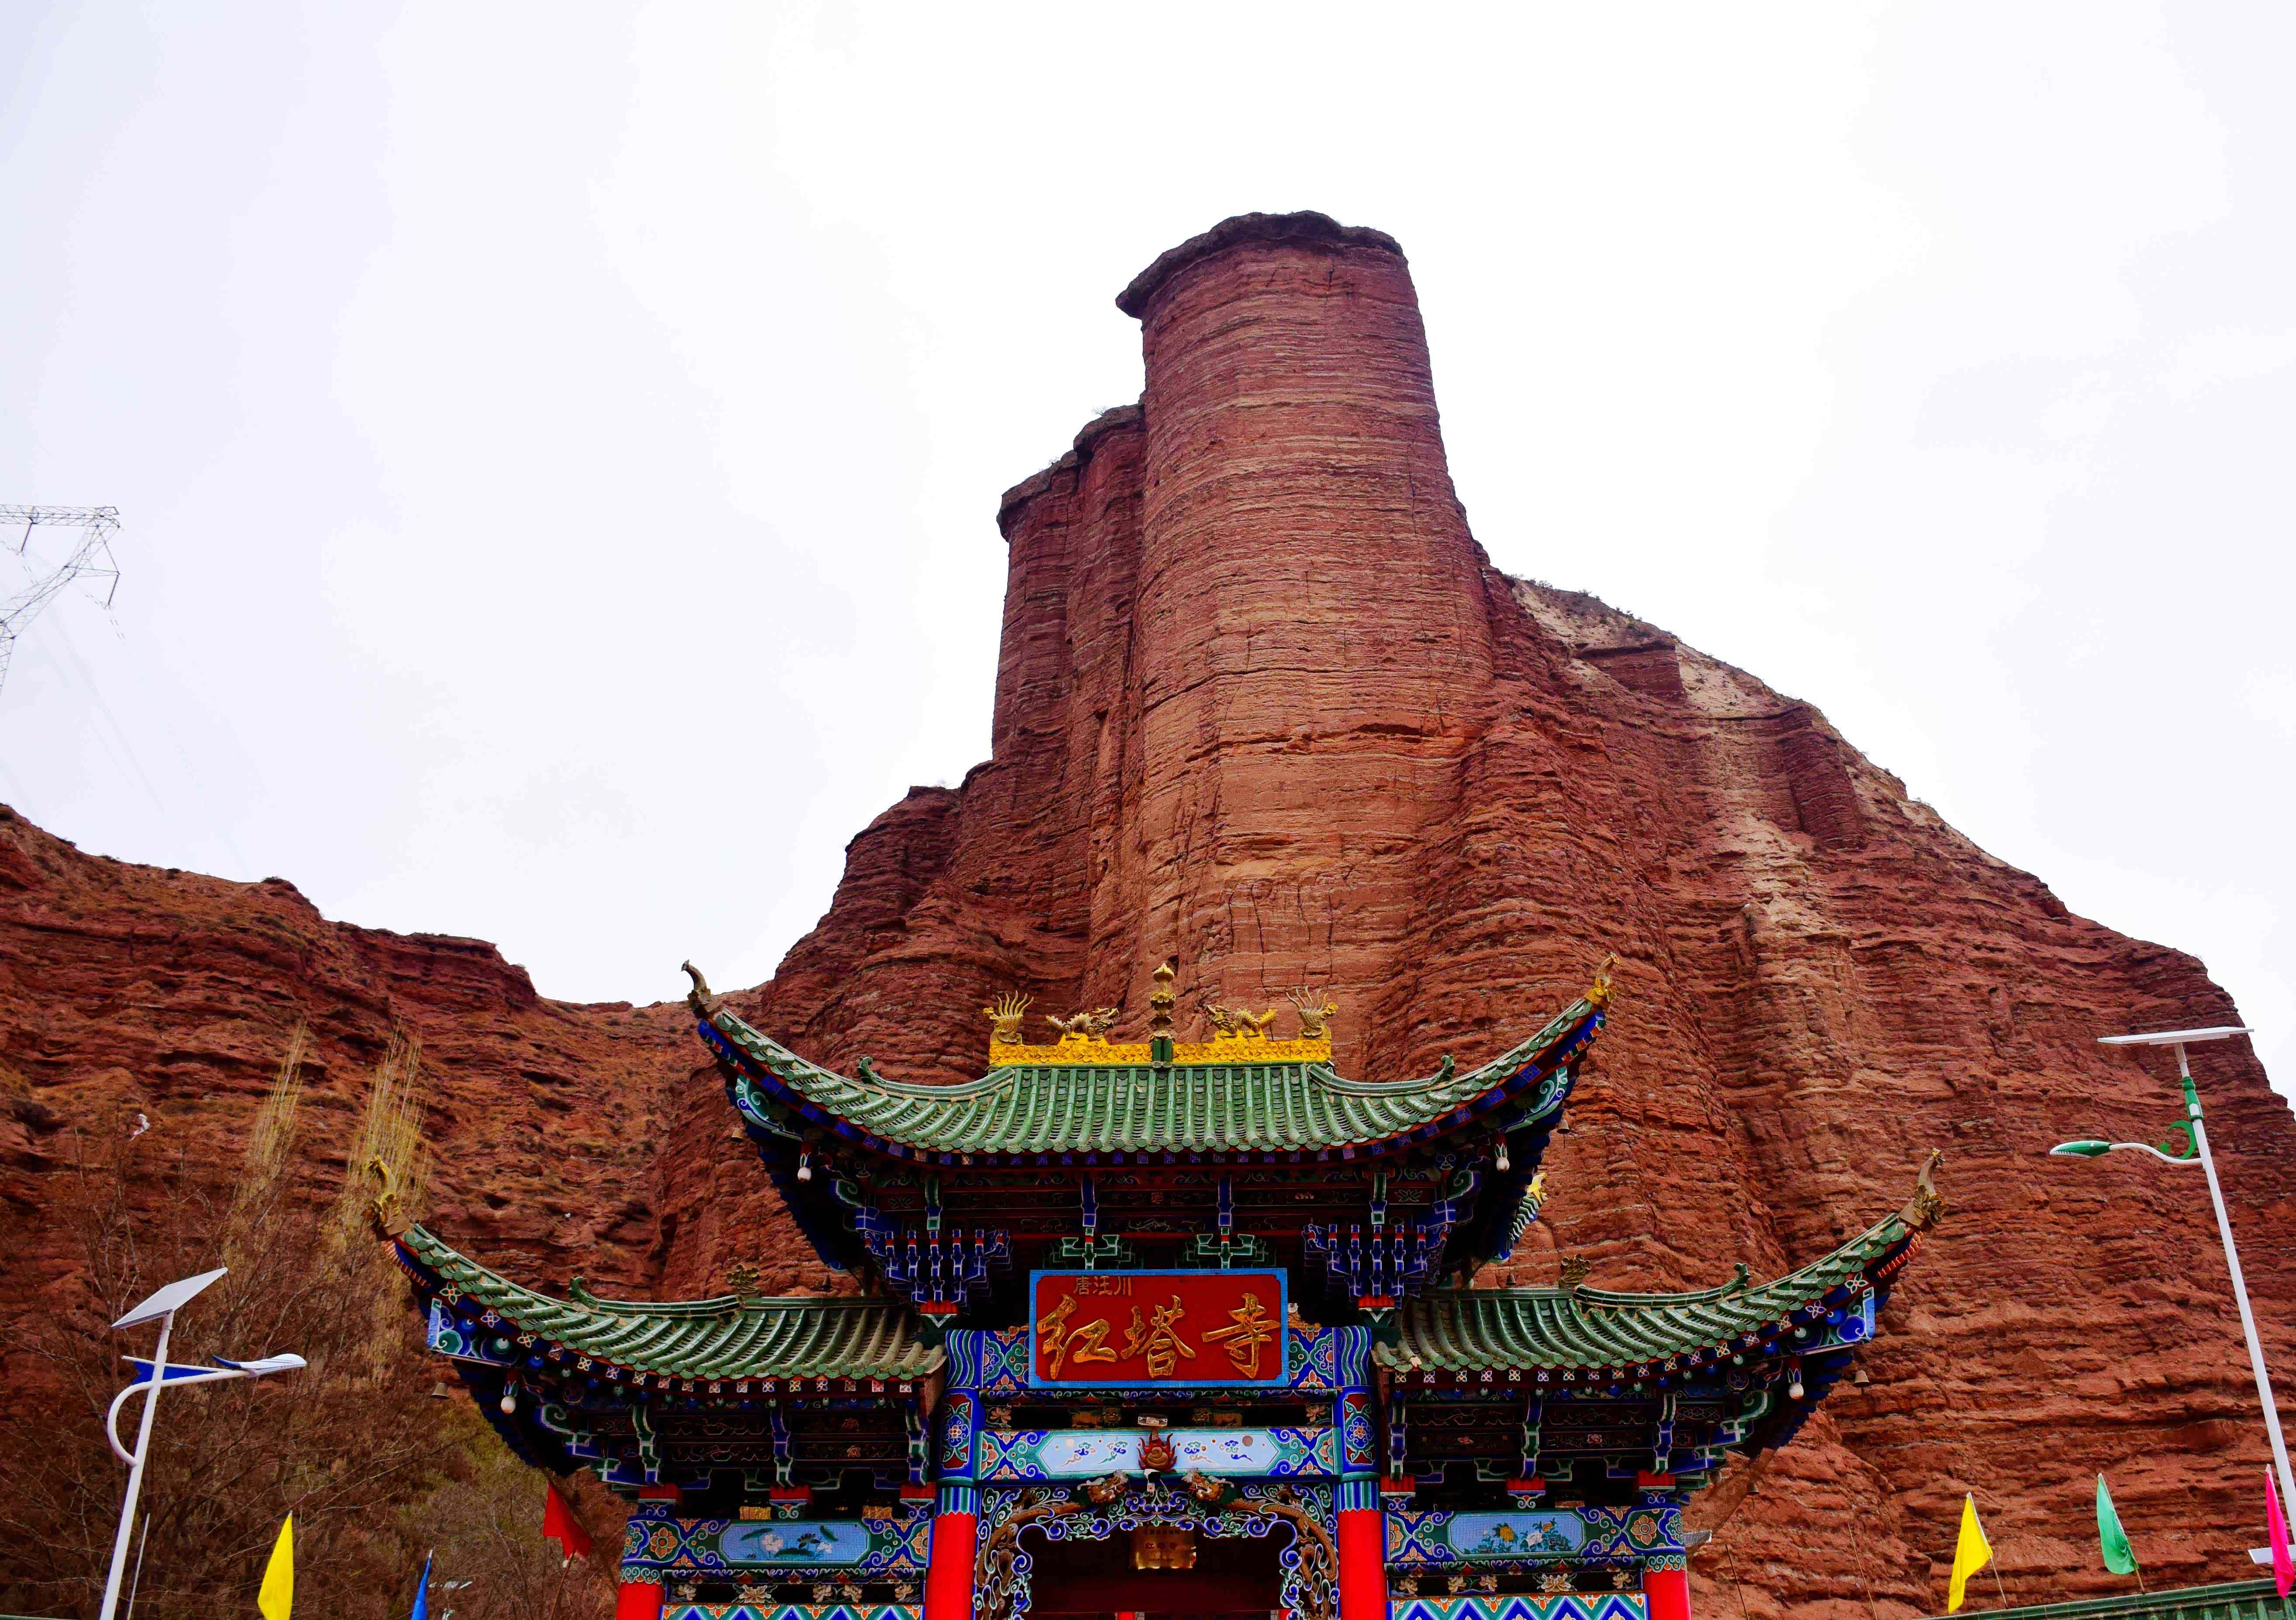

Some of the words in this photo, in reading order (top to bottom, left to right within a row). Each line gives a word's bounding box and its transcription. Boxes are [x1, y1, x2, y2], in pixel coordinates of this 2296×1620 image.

[1073, 1275, 1132, 1296] 唐汪川
[1037, 1293, 1281, 1379] 红塔寺
